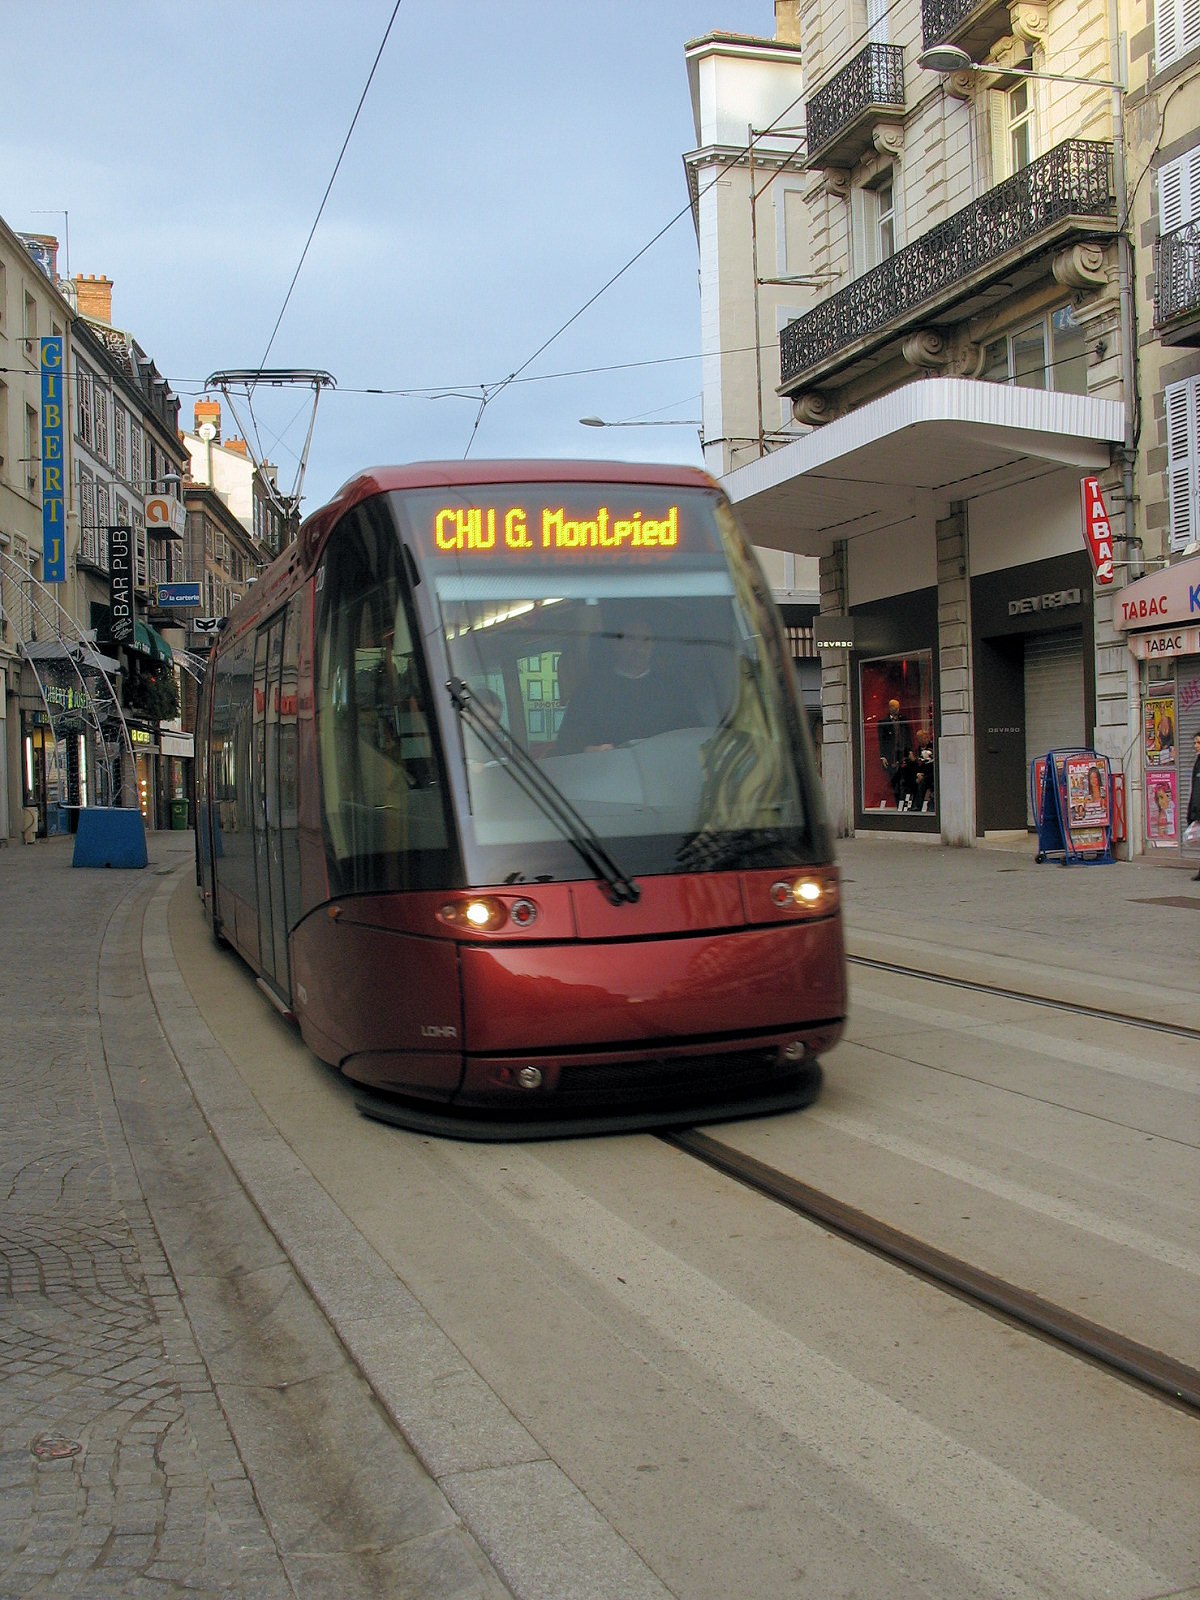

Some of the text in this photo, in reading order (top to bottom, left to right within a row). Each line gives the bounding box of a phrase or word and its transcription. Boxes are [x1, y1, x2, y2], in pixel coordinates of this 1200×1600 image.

[41, 343, 63, 576] GIBERT J.
[435, 506, 678, 549] CHU G. Montpied
[1088, 481, 1113, 578] TABAC
[113, 530, 129, 575] PUB
[113, 576, 129, 617] BAR
[1121, 595, 1168, 620] TABAC
[1146, 635, 1182, 653] TABAC
[420, 1025, 457, 1038] LOHR
